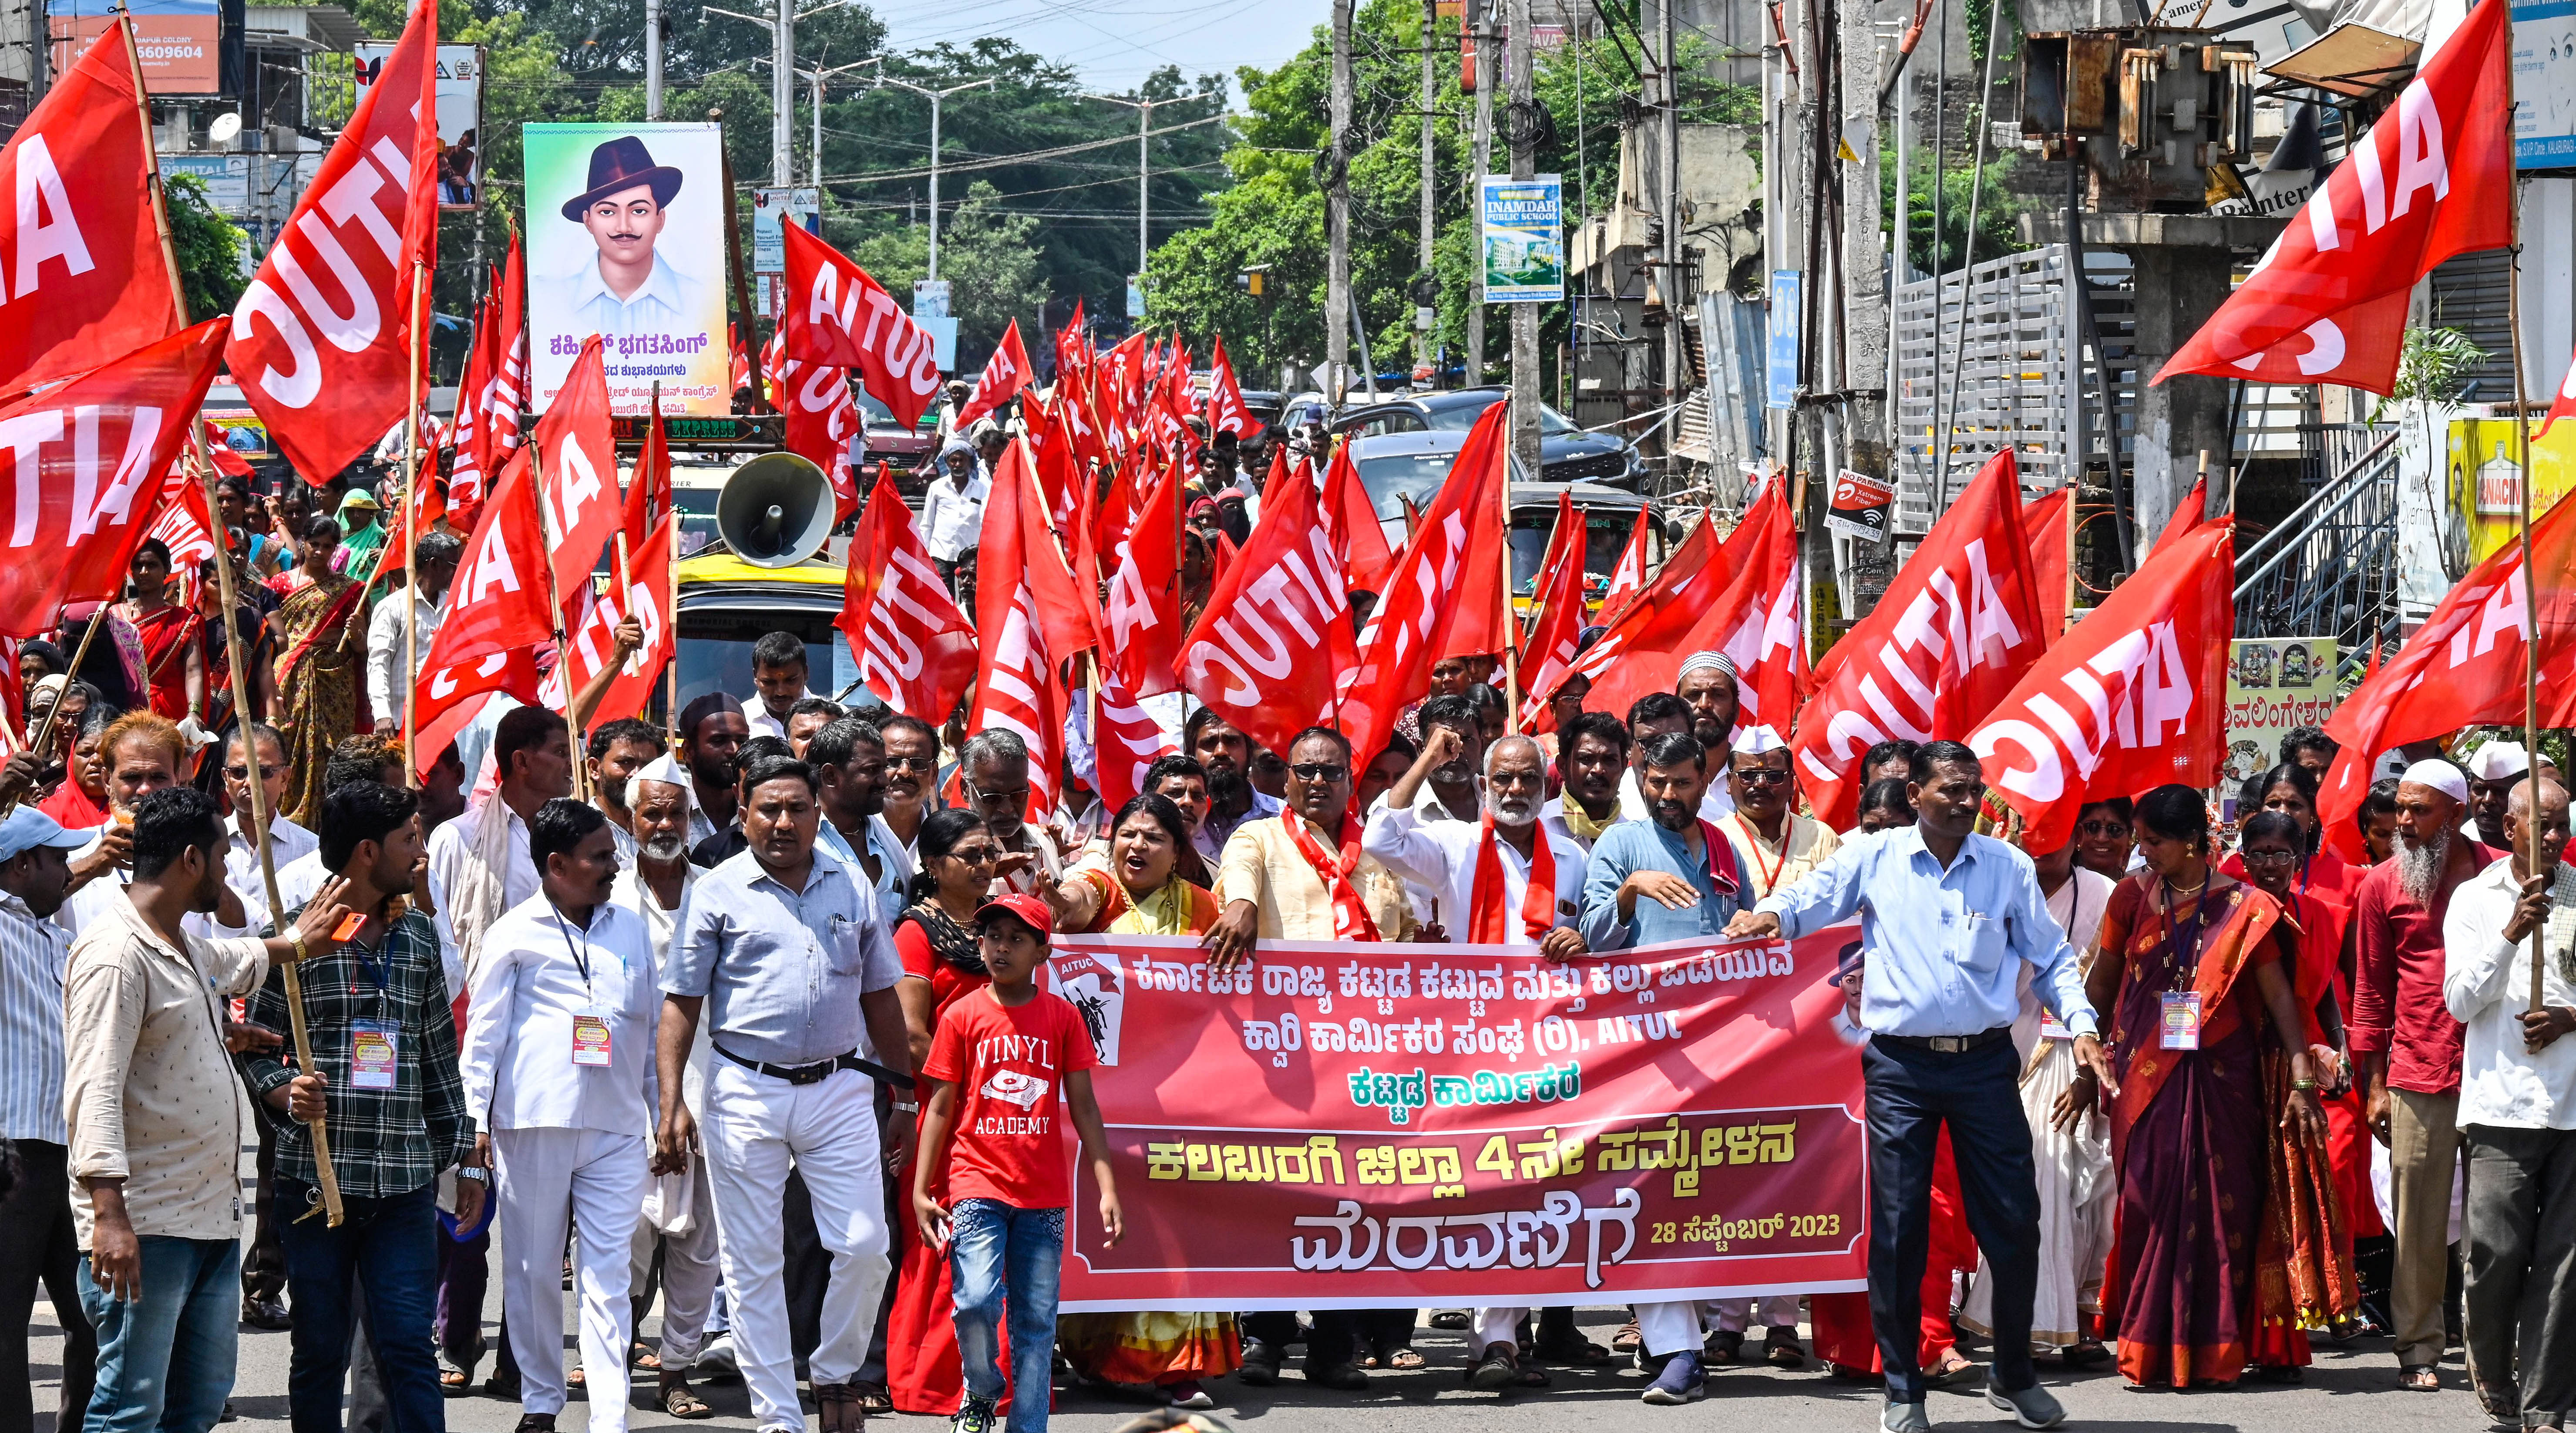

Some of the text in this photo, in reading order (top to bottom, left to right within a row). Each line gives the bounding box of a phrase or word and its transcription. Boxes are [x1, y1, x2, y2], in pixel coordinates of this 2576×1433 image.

[2158, 0, 2205, 20] Camer
[2548, 139, 2574, 154] KALABURAGI
[160, 165, 224, 175] OSPITAL
[1486, 200, 1557, 213] INAMDAR
[2218, 185, 2308, 216] Prnter
[1521, 212, 1557, 220] SCHOOL
[810, 260, 939, 396] AITUC
[619, 332, 707, 360] ಭಗತಸಿಂಗ್
[621, 364, 686, 378] ಶುಭಾಶಯಗಳು
[672, 420, 736, 438] EXPRESS
[1843, 472, 1892, 492] NO PARKING
[1854, 496, 1872, 506] Fiber
[1857, 489, 1883, 502] Xstream
[2478, 479, 2521, 506] ANACIN
[1061, 957, 1094, 975] AITUC
[1133, 939, 1794, 1017] ಕರ್ನಾಟಕ ರಾಜ್ಯ ಕಟ್ಟಡ ಕಟ್ಟುವ ಮತ್ತು ಕಲ್ಲು ಒಡೆಯುವ
[1242, 1012, 1301, 1069] ಕ್ವಾರಿ
[1309, 1016, 1444, 1055] ಕಾರ್ಮಿಕರ
[1452, 1018, 1525, 1062] ಸಂಘ
[976, 1035, 1054, 1070] VINYL
[1347, 1060, 1581, 1124] ಕಟ್ಟಡ ಕಾರ್ಮಿಕರ
[975, 1117, 1050, 1135] ACADEMY
[1147, 1113, 1796, 1199] ಕಲಬುರಗಿ ಜಿಲ್ಲಾ 4ನೇ ಸಮ್ಮೇಳನ
[1289, 1187, 1642, 1288] ಮೆರವಣಿಗೆ
[1651, 1213, 1840, 1253] 28 ಸೆಪ್ಟೆಂಬರ್ 2023
